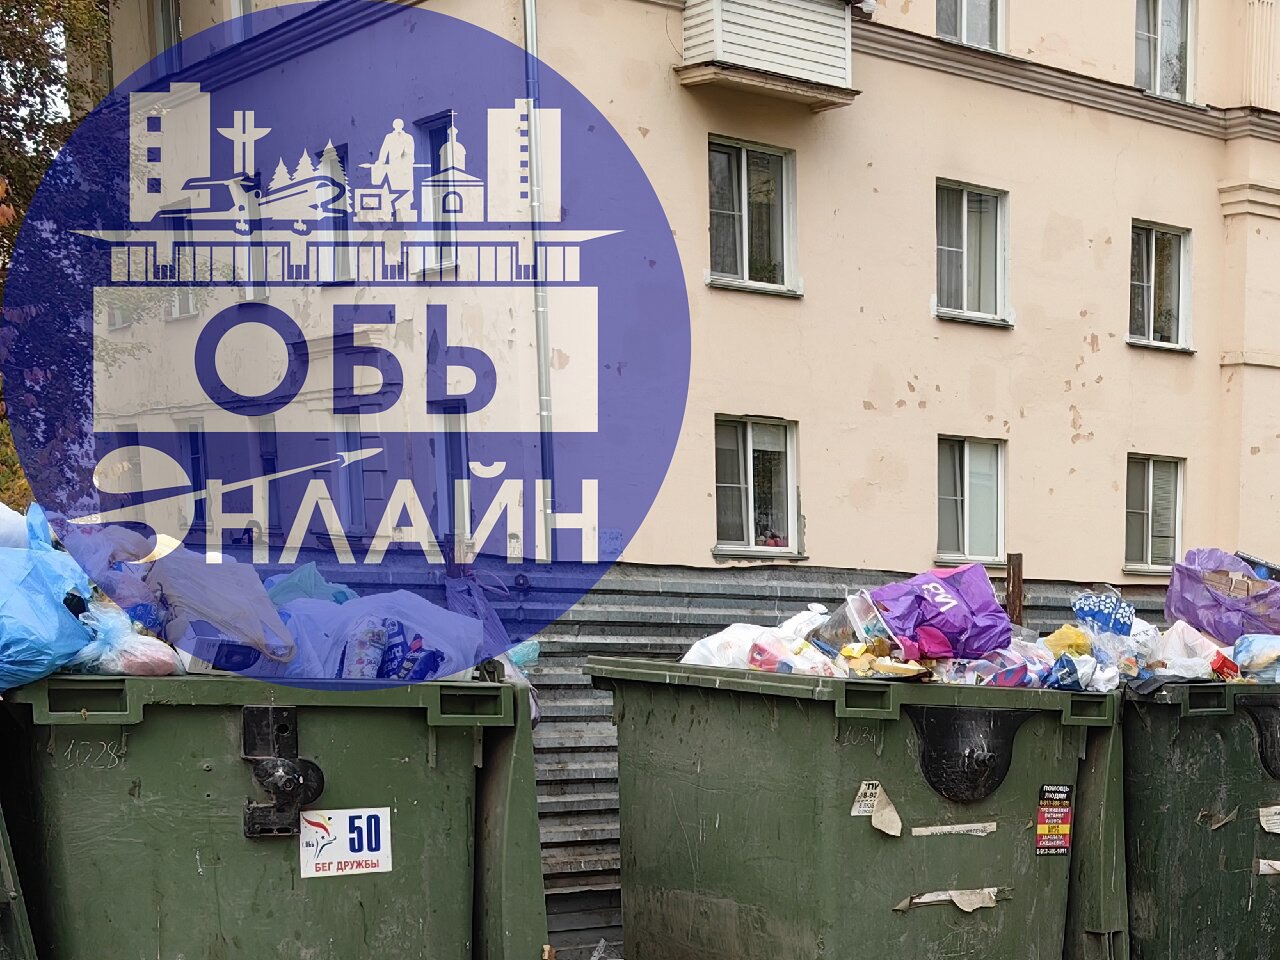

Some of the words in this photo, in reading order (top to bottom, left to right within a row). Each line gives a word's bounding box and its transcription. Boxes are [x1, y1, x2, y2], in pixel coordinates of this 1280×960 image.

[348, 814, 381, 853] 50
[315, 862, 333, 873] БЕГ
[336, 859, 380, 873] ДРУЖБЫ
